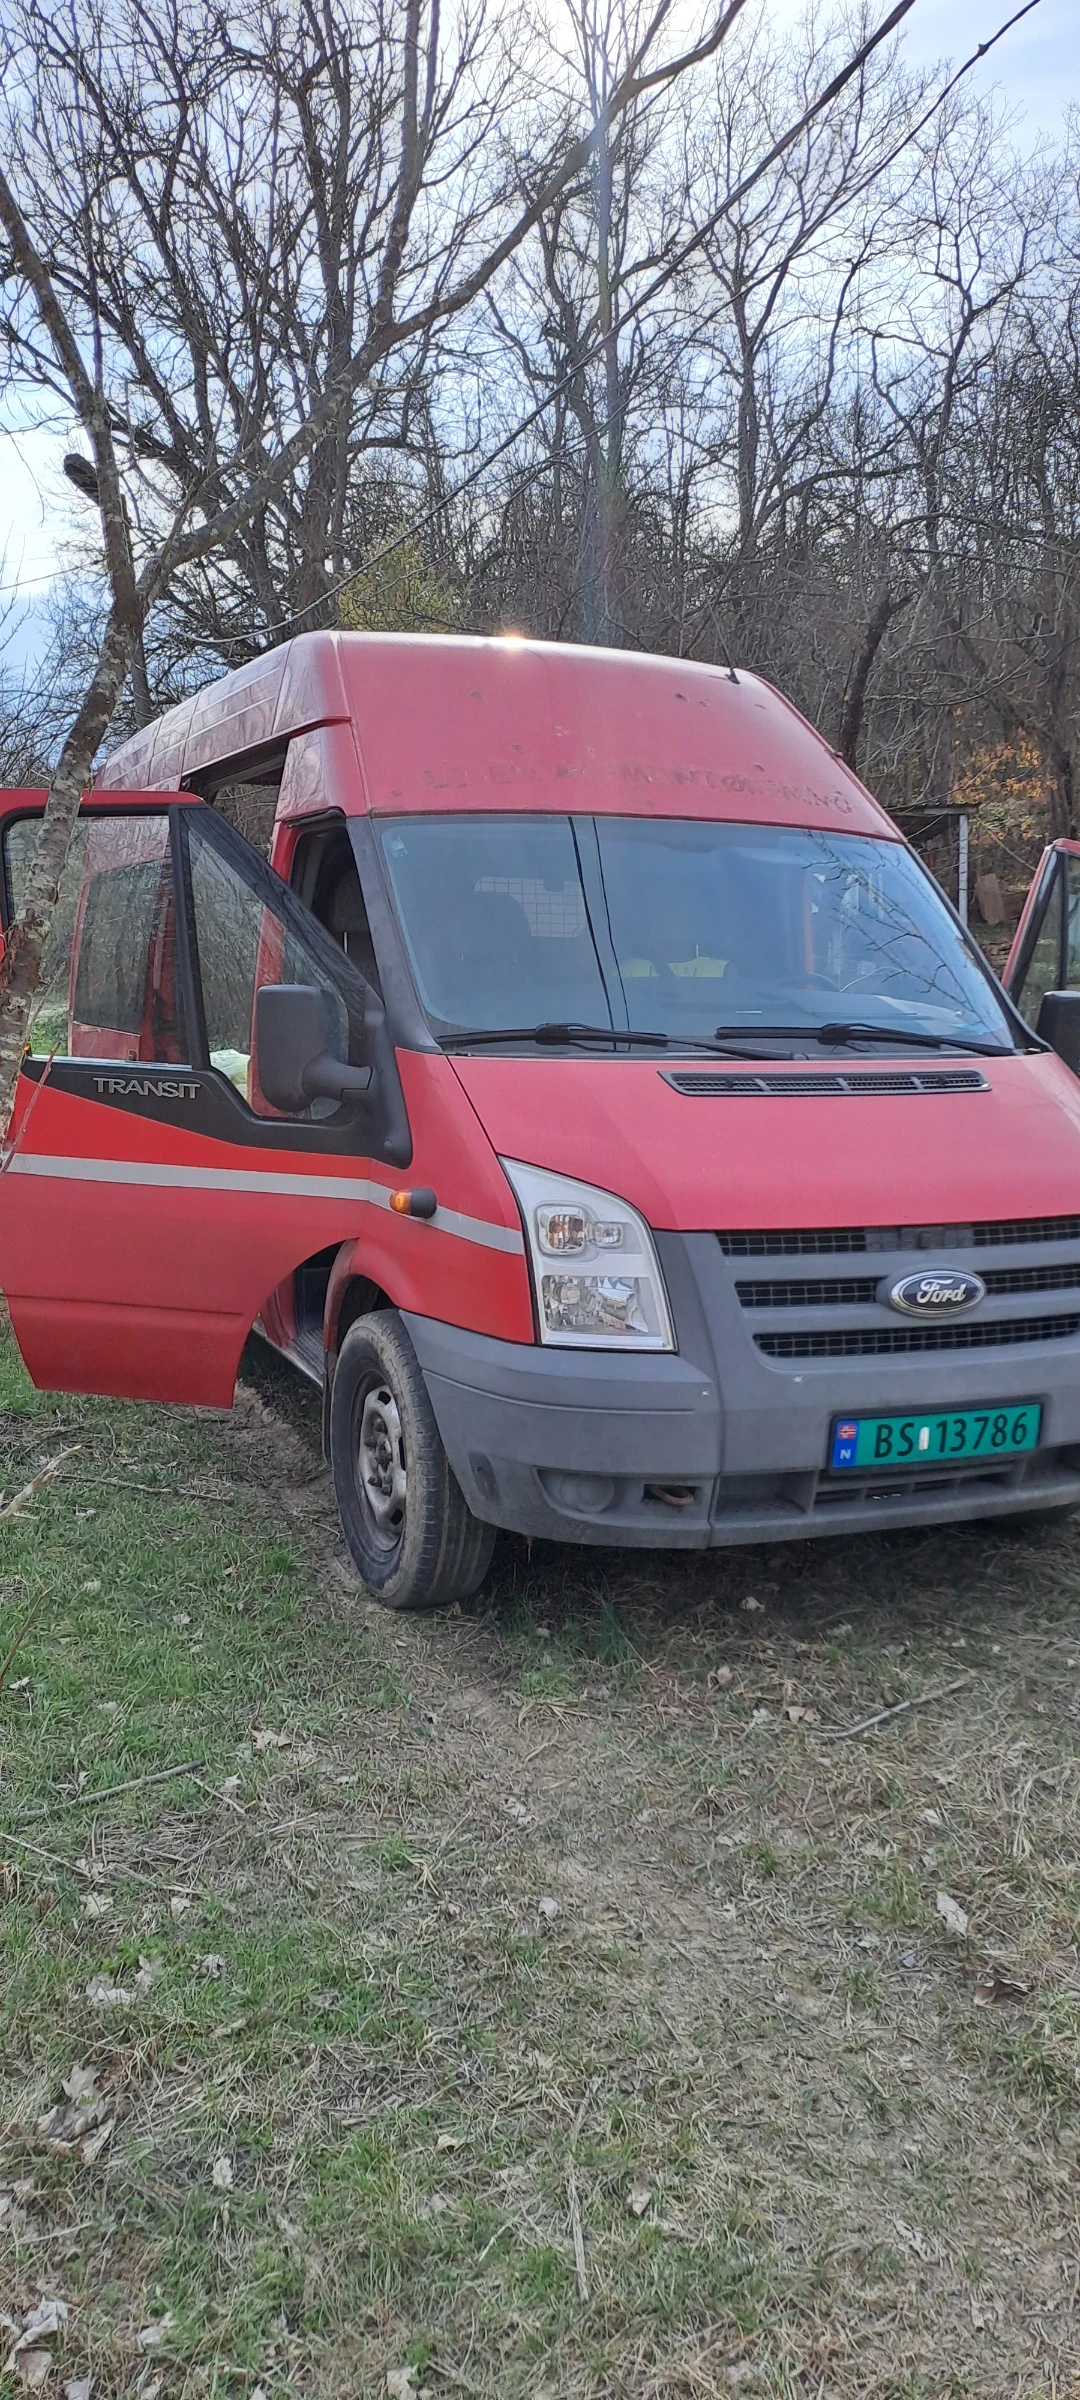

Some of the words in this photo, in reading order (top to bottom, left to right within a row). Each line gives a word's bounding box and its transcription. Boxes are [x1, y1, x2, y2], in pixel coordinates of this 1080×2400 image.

[92, 1077, 201, 1099] TRANSIT
[916, 1278, 967, 1304] Ford
[873, 1422, 915, 1459] BS
[935, 1411, 1028, 1453] 13786
[839, 1448, 852, 1460] N
